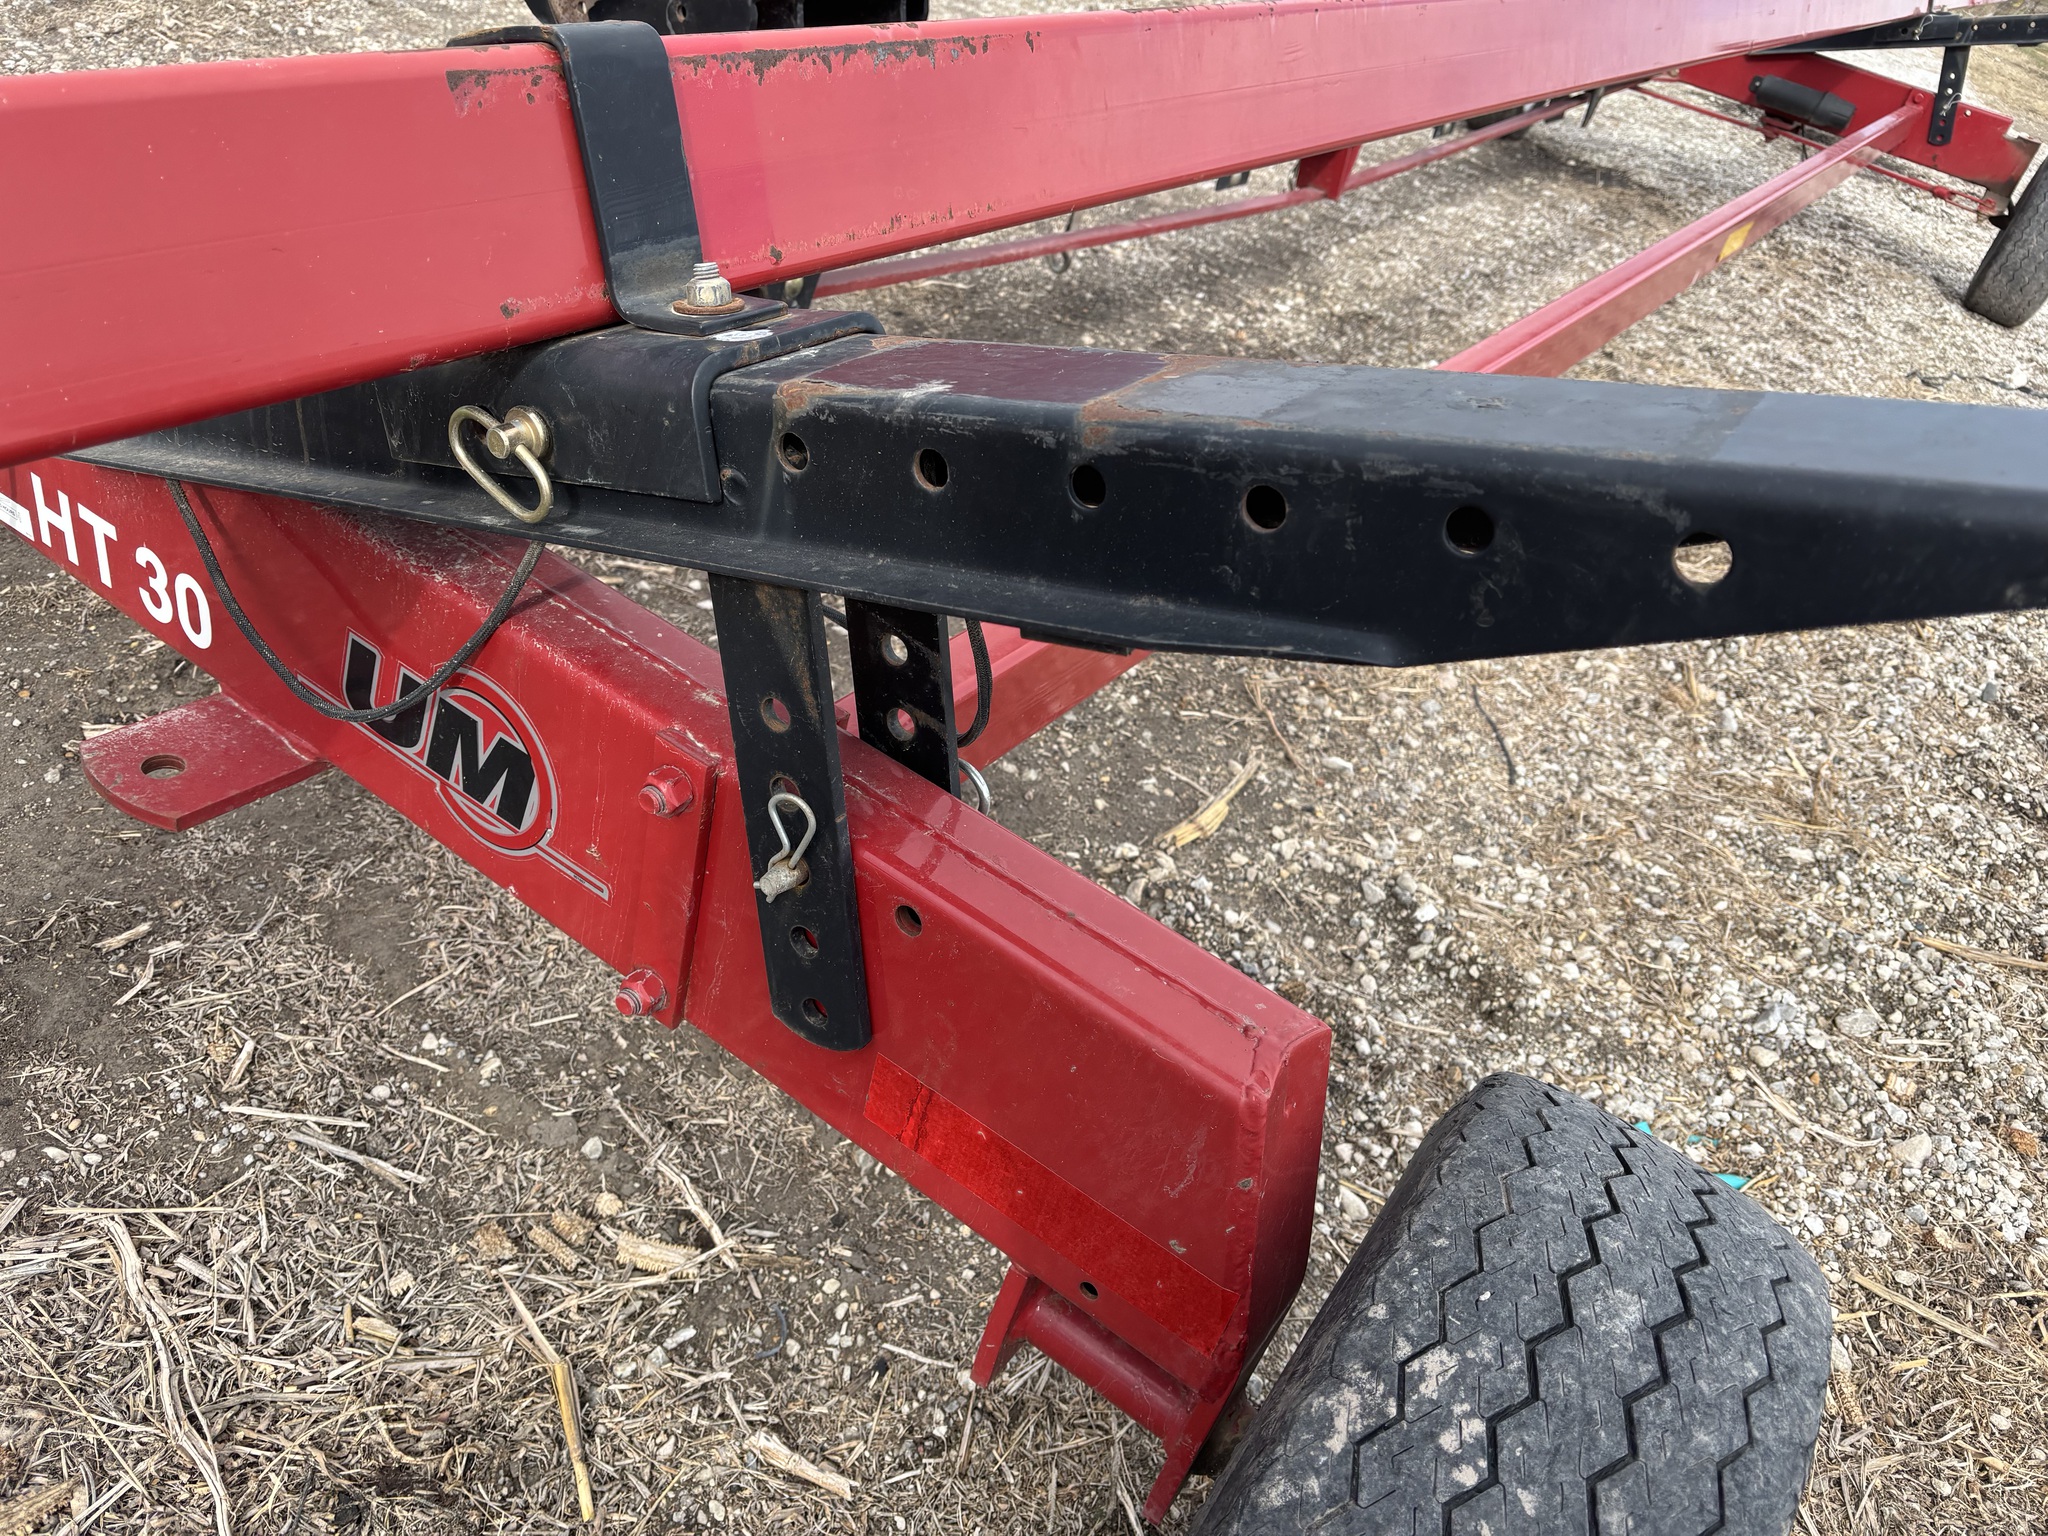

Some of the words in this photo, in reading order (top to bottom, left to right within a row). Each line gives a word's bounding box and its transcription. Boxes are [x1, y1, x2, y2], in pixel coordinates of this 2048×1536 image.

[31, 472, 117, 589] HT
[135, 546, 212, 649] 30
[344, 634, 537, 831] UM
